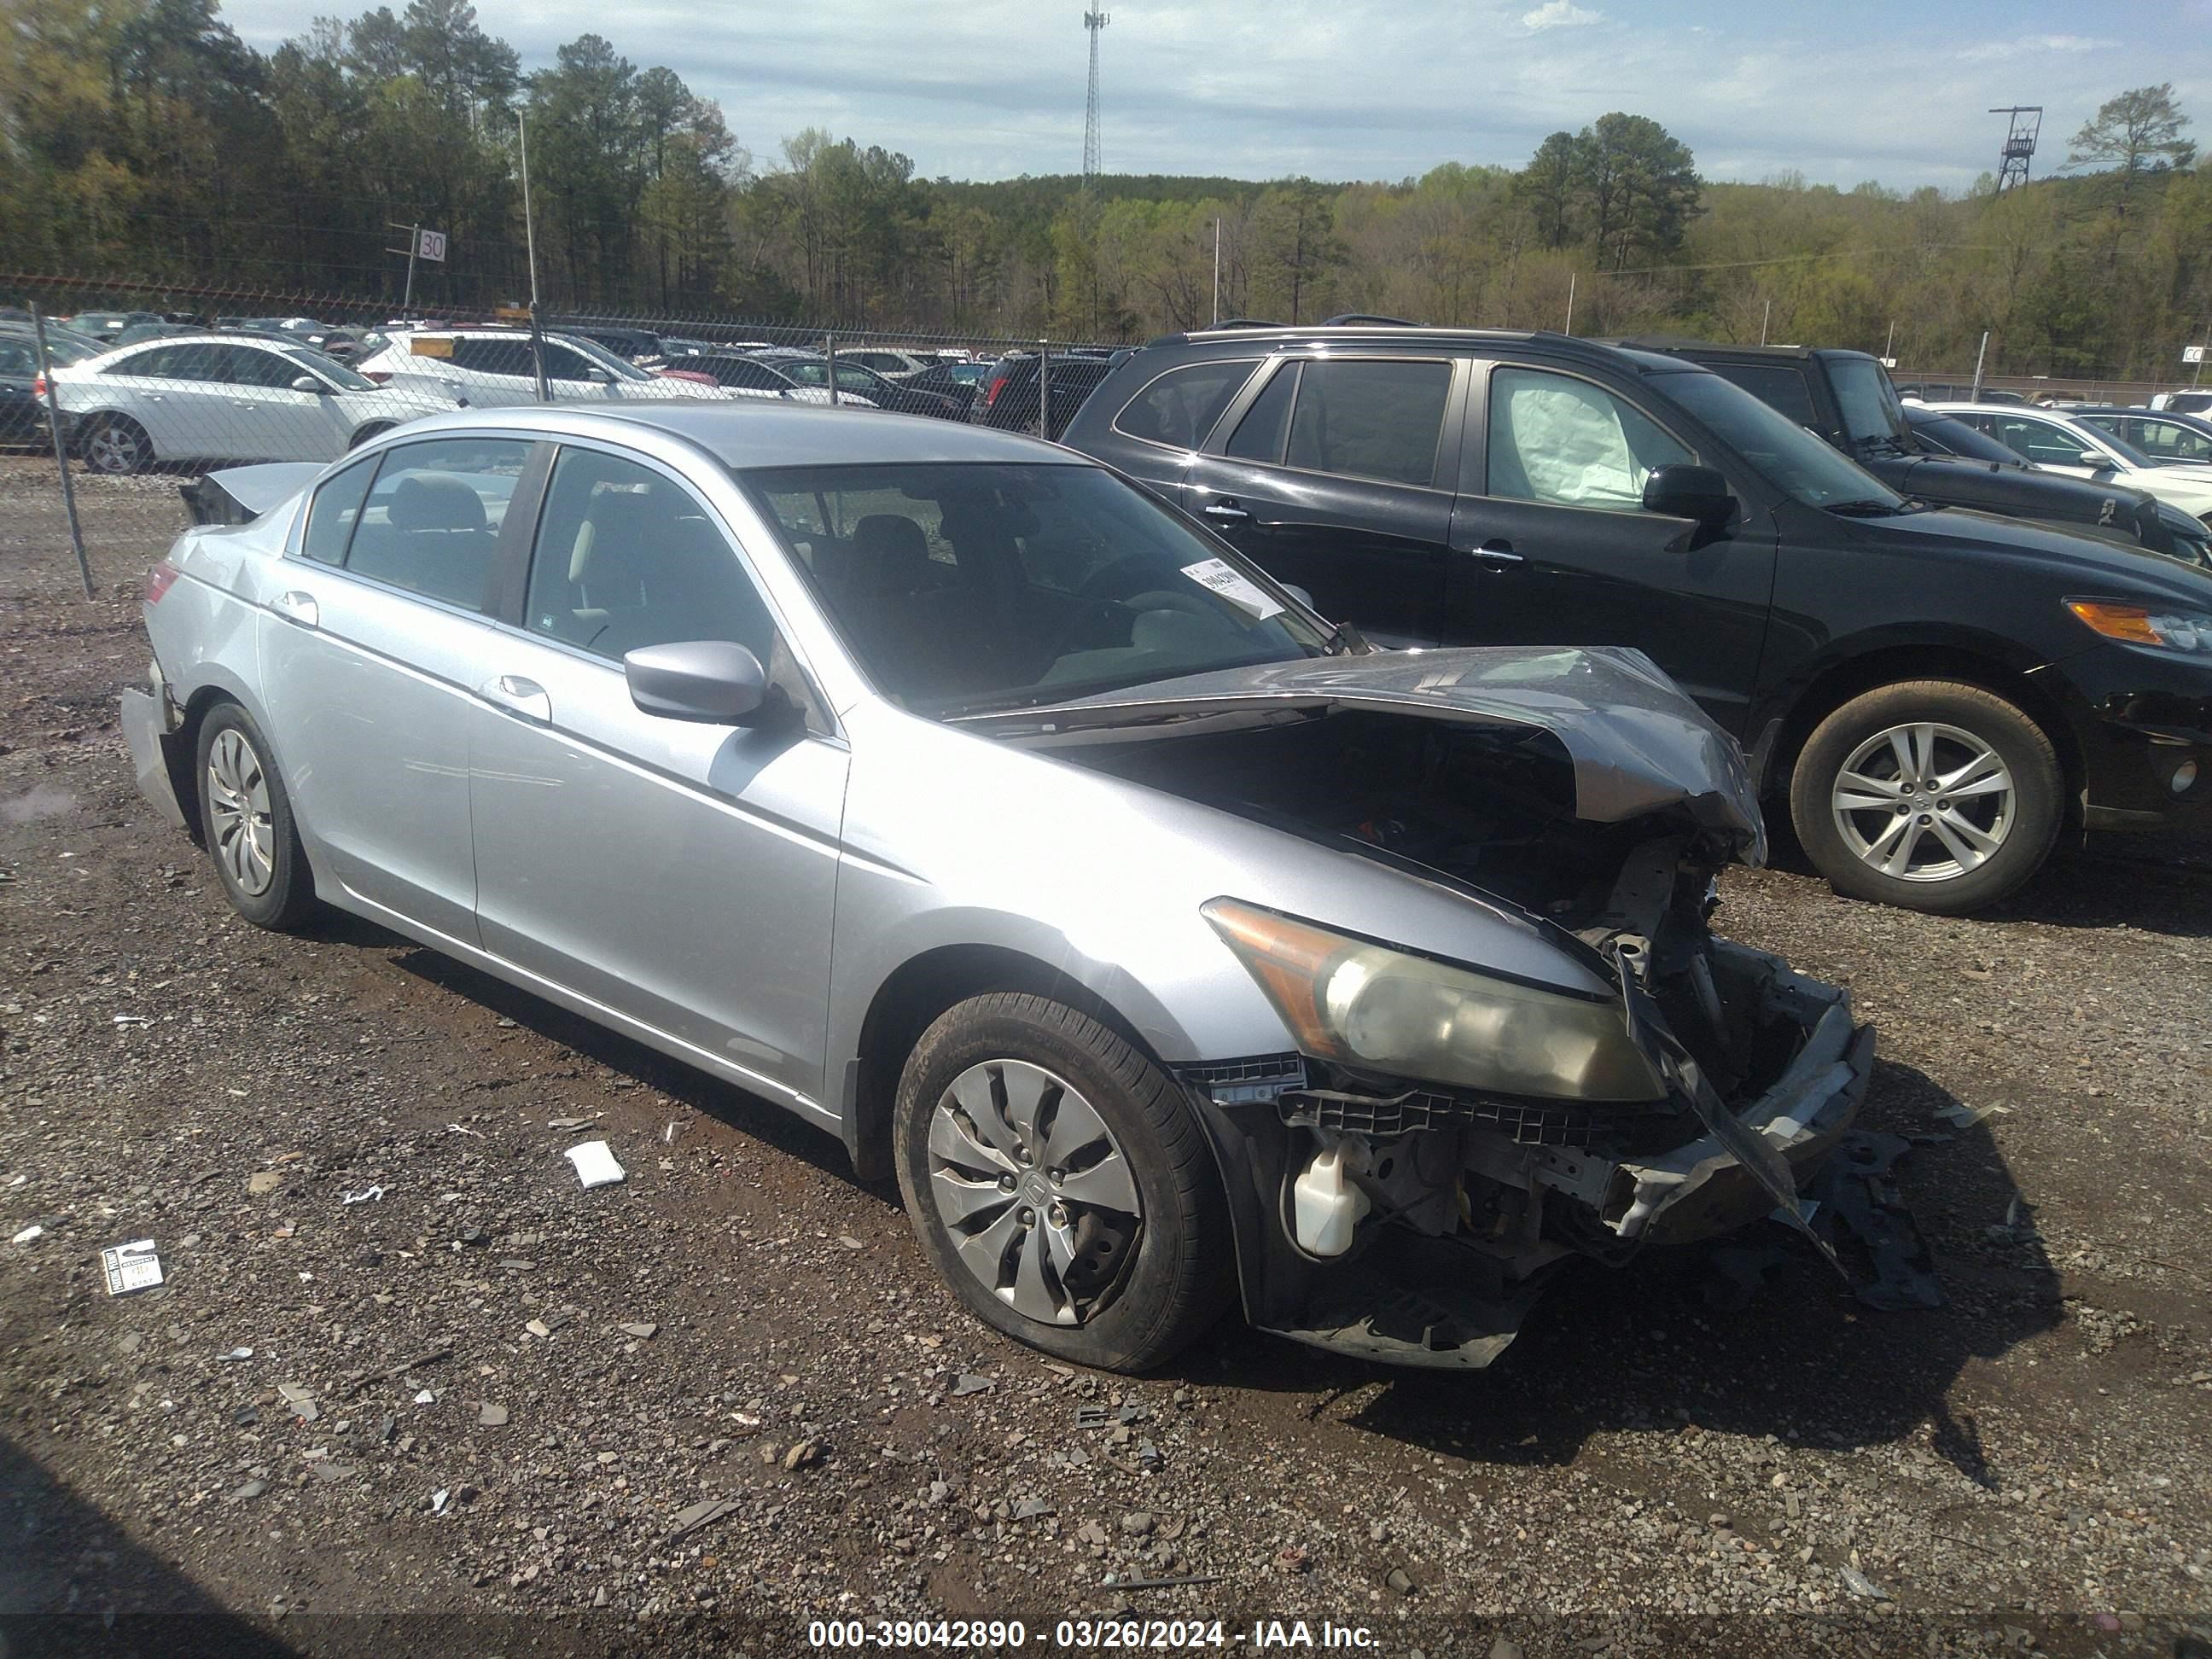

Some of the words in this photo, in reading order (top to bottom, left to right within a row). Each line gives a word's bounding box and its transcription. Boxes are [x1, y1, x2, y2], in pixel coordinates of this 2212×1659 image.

[423, 235, 443, 257] 30
[105, 1250, 119, 1270] PERMIT
[121, 1256, 155, 1268] RESIDENT
[109, 1270, 124, 1292] PARKING
